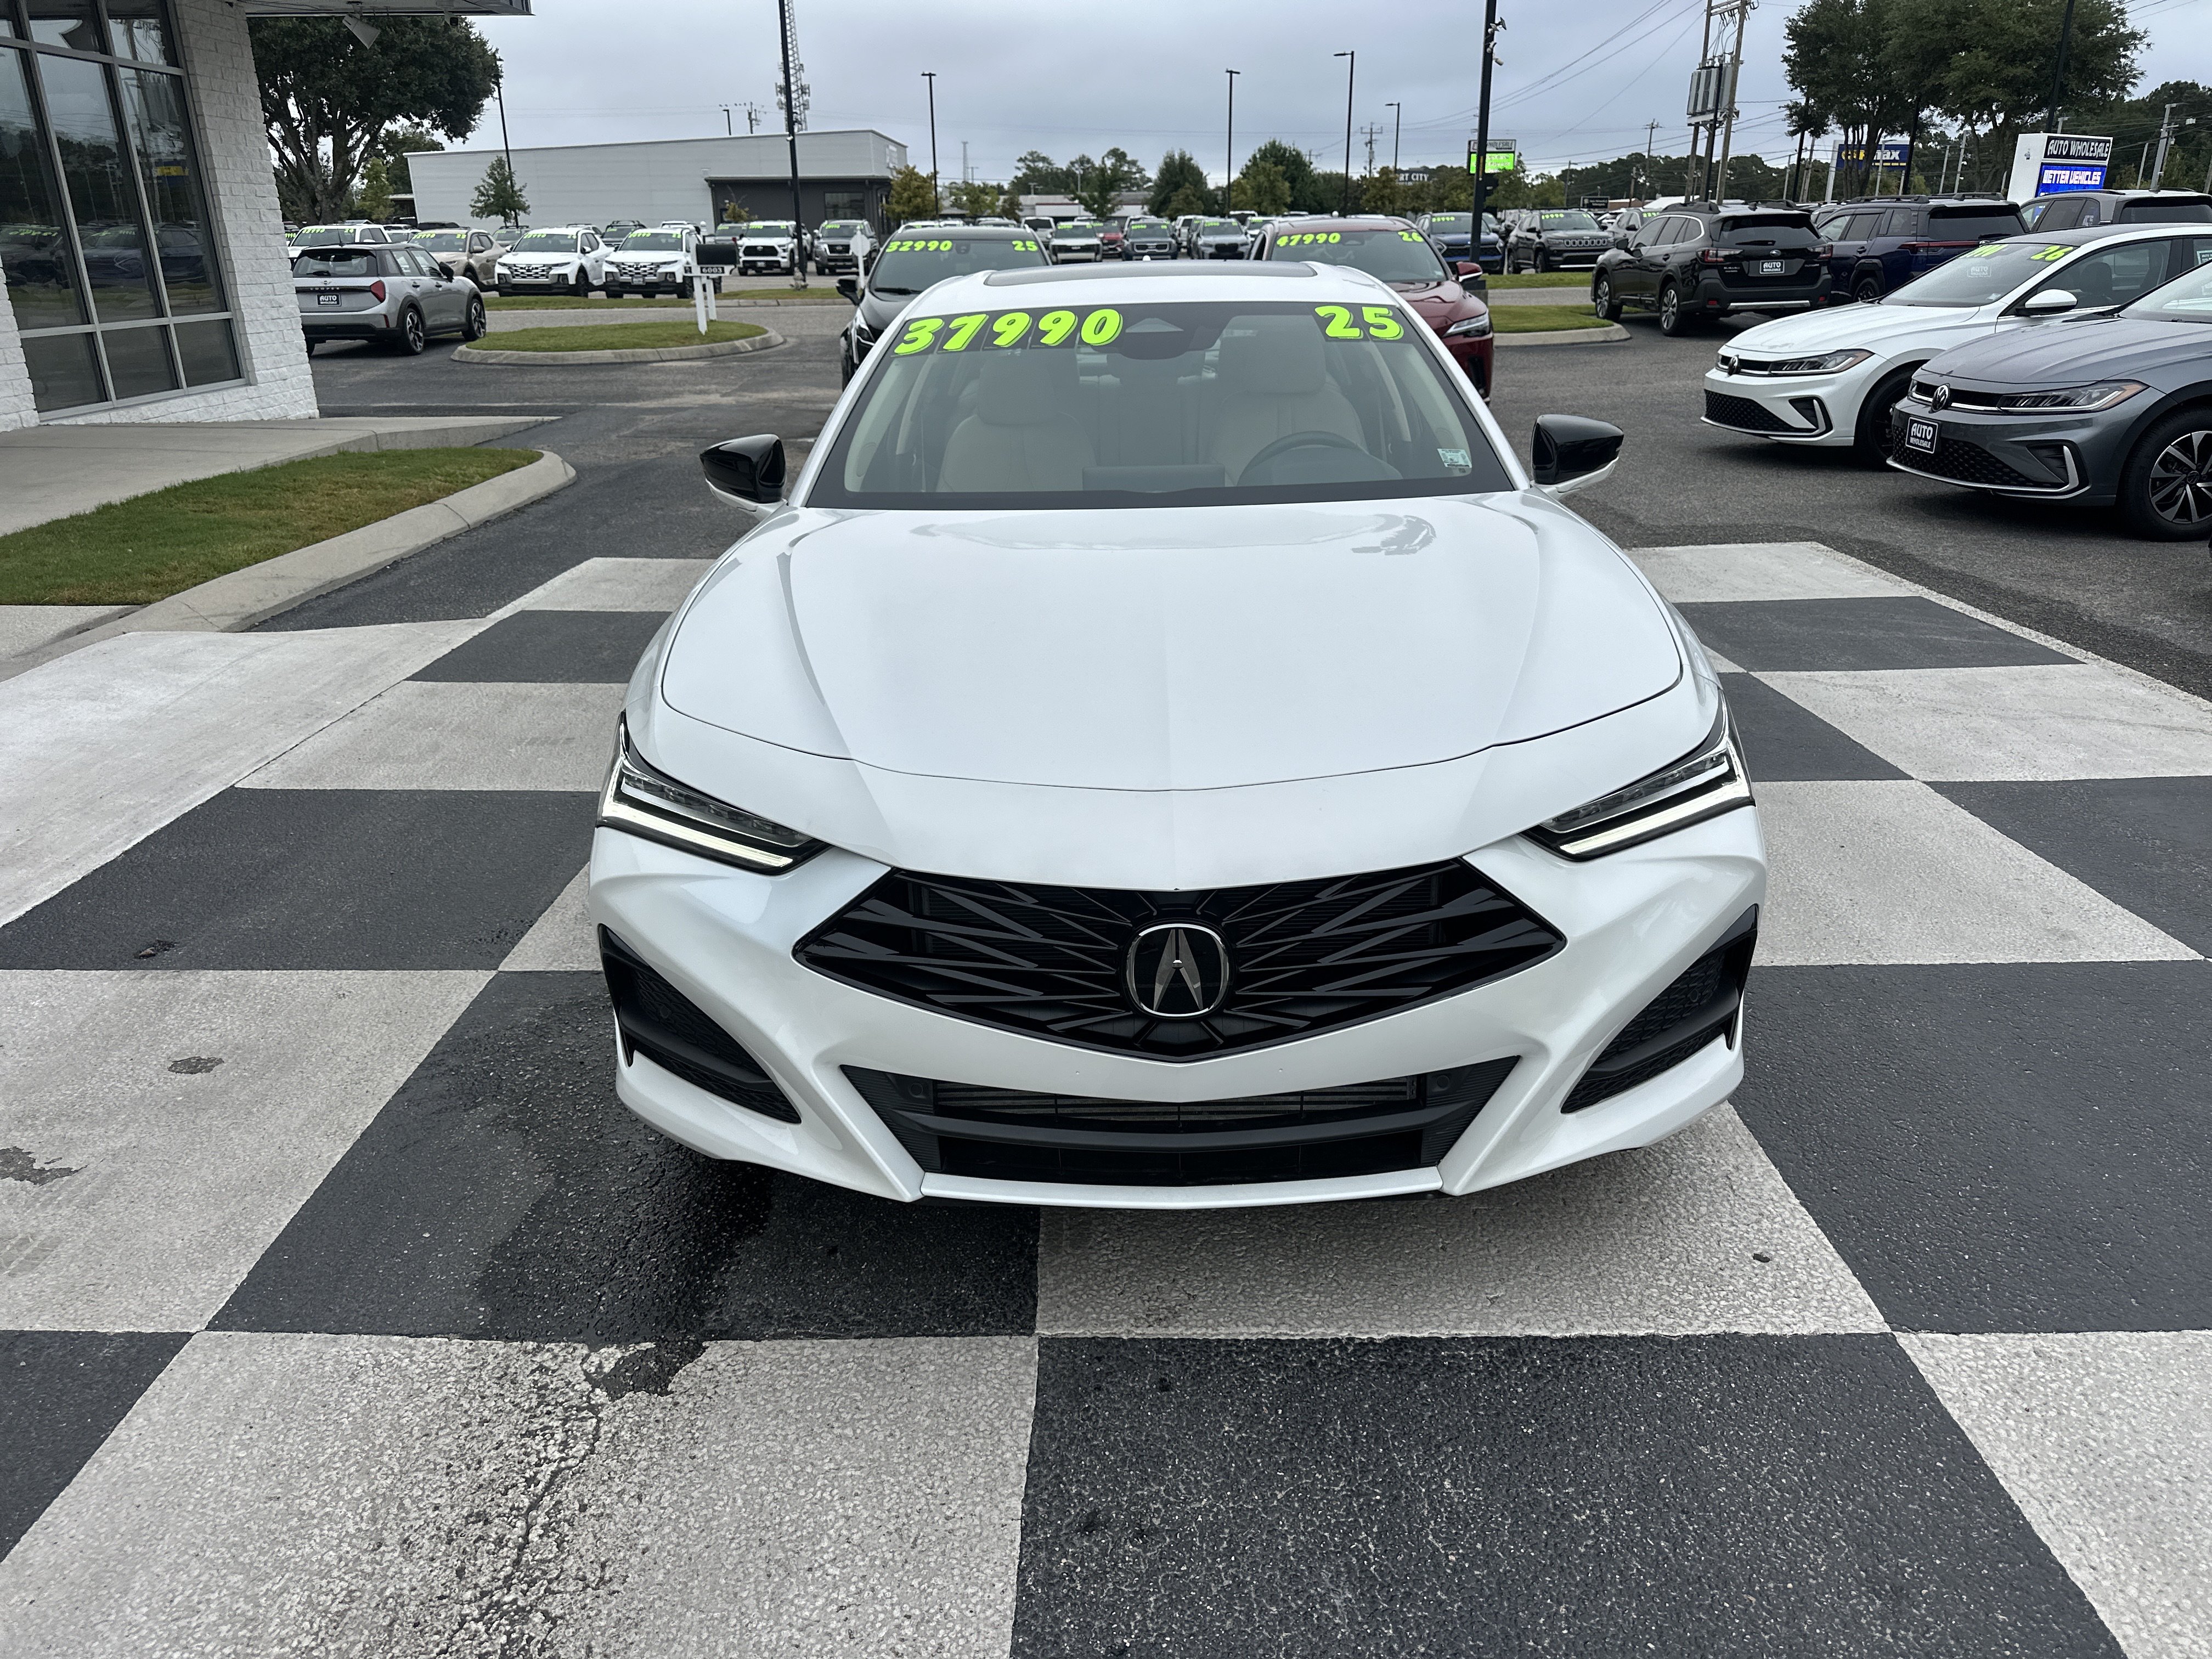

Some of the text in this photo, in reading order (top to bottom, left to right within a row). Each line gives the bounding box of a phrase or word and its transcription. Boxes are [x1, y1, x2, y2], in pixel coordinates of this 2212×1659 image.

[2047, 139, 2109, 158] AUTO WHOLESALE
[1411, 173, 1429, 182] CITY
[2069, 171, 2102, 185] VEHICLES
[885, 240, 1038, 252] 32990 25
[1277, 231, 1424, 247] 47990 26
[2030, 245, 2073, 261] 26
[894, 305, 1404, 356] 37990 25
[1911, 423, 1933, 439] AUTO
